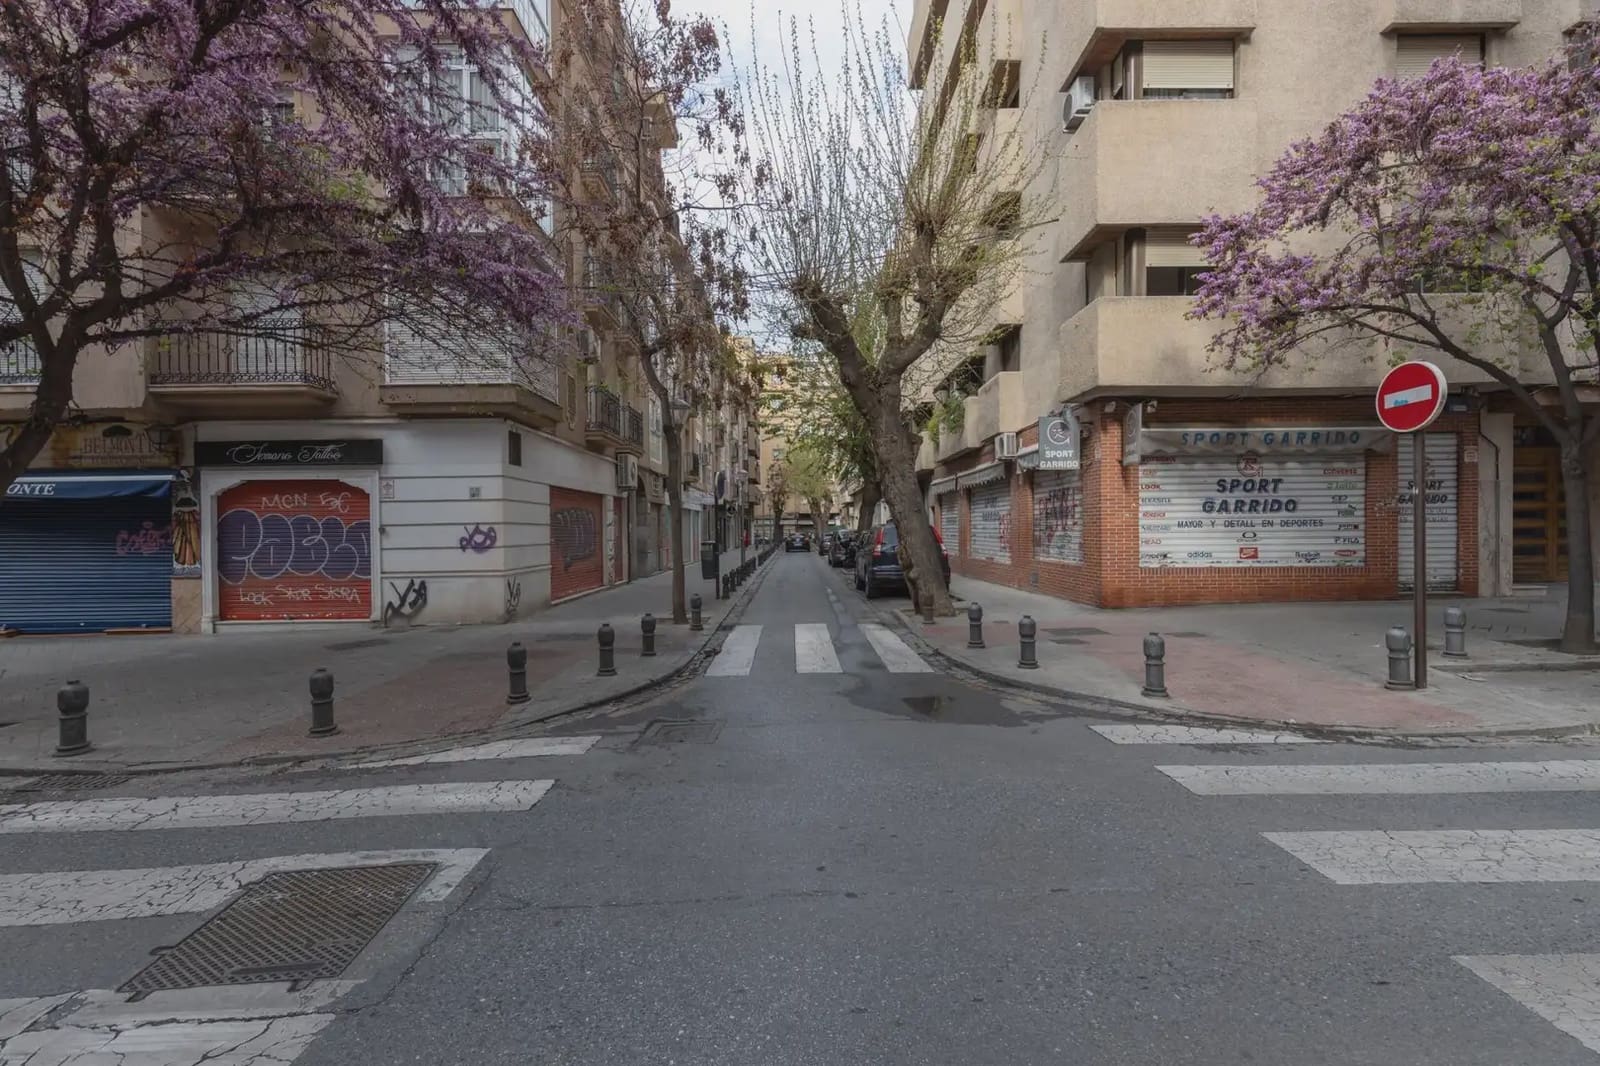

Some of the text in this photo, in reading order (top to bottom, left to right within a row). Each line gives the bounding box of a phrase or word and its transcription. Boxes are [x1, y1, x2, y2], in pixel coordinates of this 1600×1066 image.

[1180, 431, 1361, 446] SPORT GARRIDO
[1045, 450, 1074, 458] SPORT
[1040, 460, 1079, 468] GARRIDO
[1216, 478, 1284, 493] SPORT
[1202, 499, 1298, 513] GARRIDO
[1177, 520, 1203, 528] MAYOR
[1210, 520, 1217, 528] Y
[1223, 520, 1256, 528] DETALL
[1279, 519, 1324, 528] DEPORTES
[1186, 551, 1213, 559] adidas
